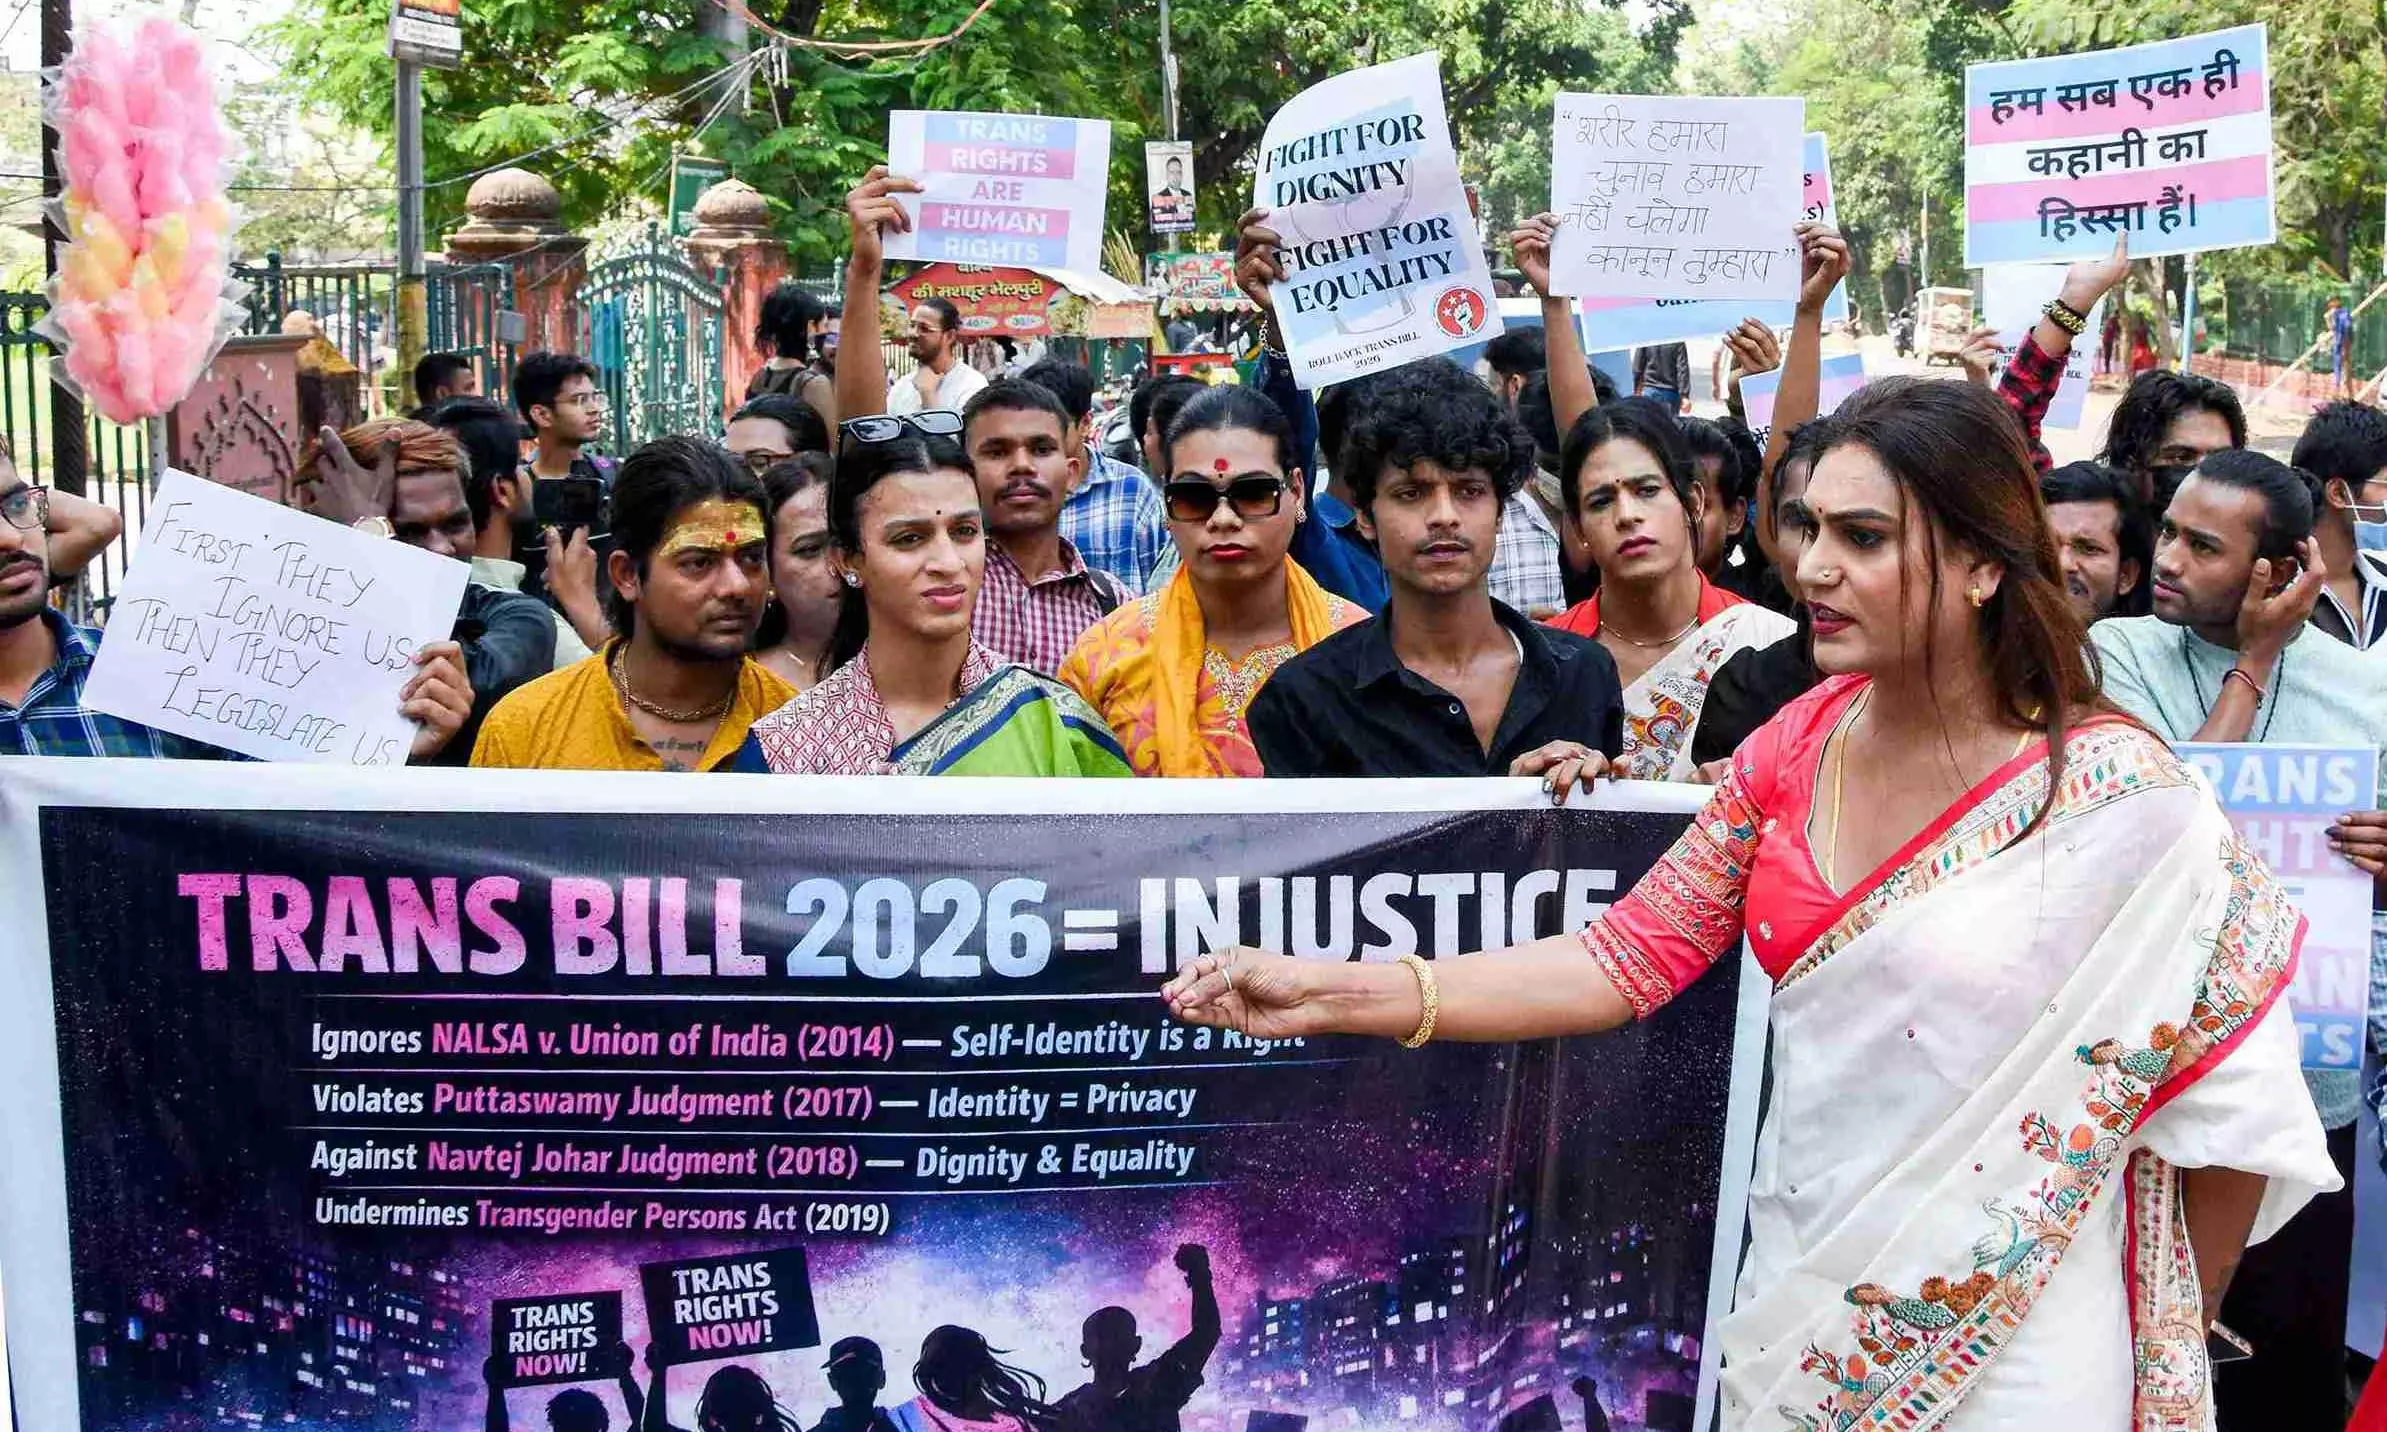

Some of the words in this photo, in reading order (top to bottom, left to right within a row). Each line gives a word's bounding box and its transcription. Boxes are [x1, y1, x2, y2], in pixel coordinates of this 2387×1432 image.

[1990, 87, 2046, 124] हम
[2056, 79, 2119, 113] सब
[2128, 67, 2193, 111] एक
[2201, 49, 2240, 100] ही
[957, 119, 1047, 143] TRANS
[1265, 127, 1349, 173] FIGHT
[1356, 114, 1426, 151] FOR
[1648, 120, 1729, 152] हमारा
[951, 149, 1048, 173] RIGHTS
[2026, 127, 2148, 180] कहानी
[2157, 129, 2208, 162] का
[971, 180, 1025, 201] ARE
[1276, 158, 1406, 208] DIGNITY
[1684, 163, 1764, 194] हमारा
[941, 208, 1048, 233] HUMAN
[1562, 195, 1613, 231] नहीं
[1624, 197, 1710, 235] चलेगा
[2038, 196, 2148, 243] हिस्सा
[2156, 184, 2196, 235] हैं।
[943, 238, 1039, 262] RIGHTS
[1273, 231, 1373, 271] FIGHT
[1378, 217, 1454, 251] FOR
[1290, 251, 1453, 313] EQUALITY
[1308, 354, 1333, 370] ROLL
[1334, 347, 1362, 363] BACK
[1364, 338, 1398, 353] TRANS
[1398, 331, 1421, 345] BILL
[153, 502, 253, 570] FIRST
[273, 541, 376, 607] THEY
[128, 598, 222, 662] THEN
[227, 632, 321, 689] THEY
[206, 576, 349, 656] IGNORE
[364, 629, 415, 672] US
[162, 665, 347, 754] LEGISLATE
[352, 731, 398, 766] US
[2188, 753, 2357, 806] RANS
[177, 872, 528, 976] TRANS
[550, 877, 766, 977] BILL
[785, 877, 1052, 979] 2026
[1064, 910, 1118, 951] =
[312, 1022, 422, 1060] Ignores
[432, 1023, 529, 1055] NALSA
[538, 1031, 562, 1055] v.
[570, 1022, 659, 1056] Union
[668, 1023, 703, 1057] of
[711, 1024, 788, 1058] India
[798, 1023, 896, 1062] (2014)
[949, 1020, 1151, 1061] Self-Identity
[1159, 1018, 1185, 1051] is
[1193, 1026, 1211, 1051] a
[312, 1083, 425, 1114] Violates
[433, 1082, 622, 1122] Puttaswamy
[627, 1084, 775, 1123] Judgment
[783, 1085, 873, 1121] (2017)
[927, 1085, 1050, 1123] Identity
[1060, 1091, 1078, 1108] =
[1087, 1082, 1197, 1117] Privacy
[310, 1140, 418, 1177] Against
[427, 1141, 524, 1180] Navtej
[530, 1143, 612, 1174] Johar
[616, 1143, 758, 1182] Judgment
[766, 1143, 859, 1180] (2018)
[916, 1144, 1028, 1183] Dignity
[1037, 1143, 1063, 1174] &
[1071, 1139, 1196, 1179] Equality
[315, 1197, 469, 1227] Undermines
[476, 1199, 638, 1234] Transgender
[644, 1202, 747, 1230] Persons
[754, 1203, 797, 1231] Act
[805, 1201, 890, 1236] (2019)
[672, 1261, 772, 1297] TRANS
[510, 1301, 595, 1329] TRANS
[674, 1290, 780, 1325] RIGHTS
[508, 1325, 598, 1353] RIGHTS
[688, 1319, 773, 1351] NOW!
[515, 1351, 587, 1377] NOW!
